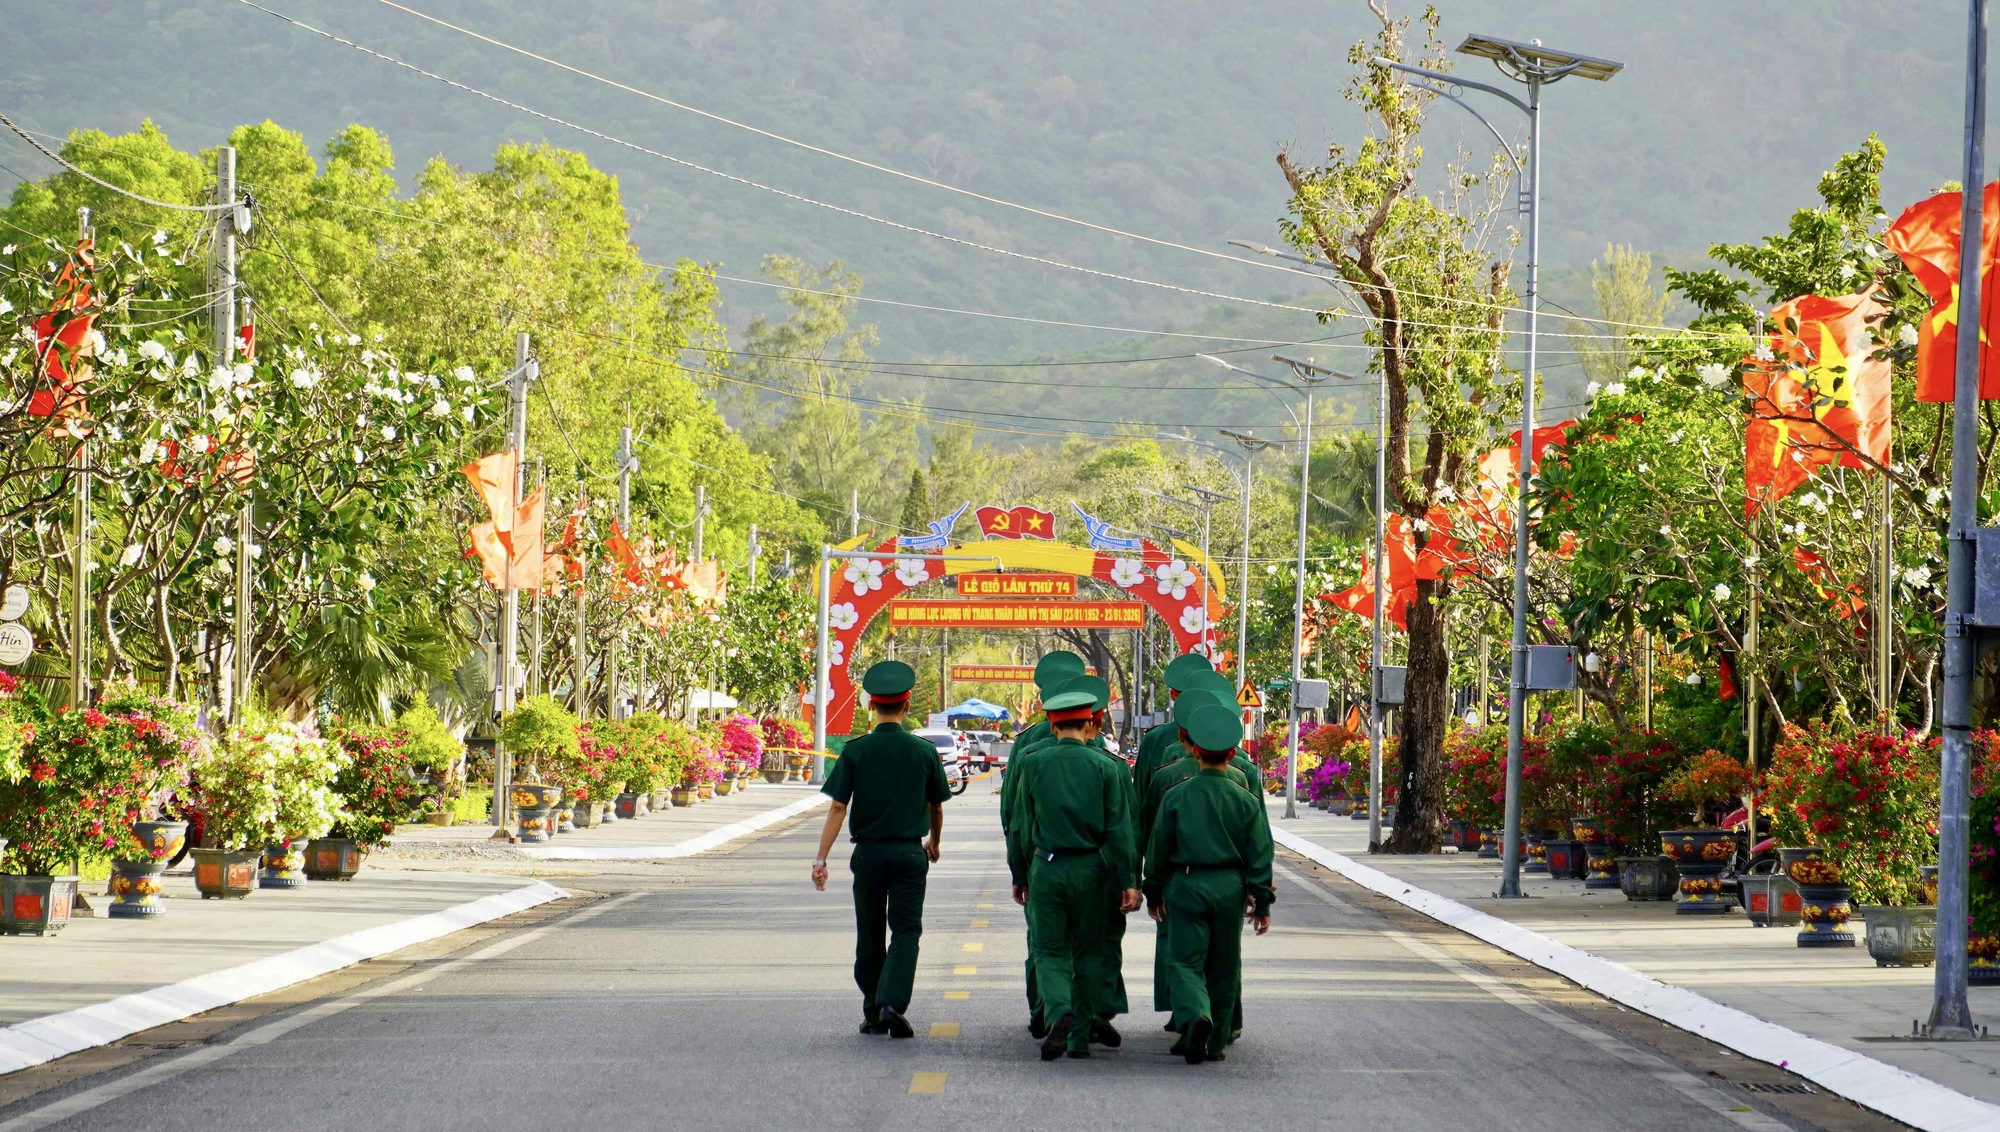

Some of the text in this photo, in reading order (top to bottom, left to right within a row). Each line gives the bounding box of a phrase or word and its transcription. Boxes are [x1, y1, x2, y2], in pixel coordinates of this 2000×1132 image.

[963, 577, 1070, 593] LỄ GIỖ LẦN THỨ 74
[893, 607, 908, 620] ANH
[908, 605, 926, 620] HÙNG
[927, 607, 939, 622] LỰC
[939, 607, 962, 622] LƯỢNG
[972, 607, 994, 621] TRANG
[994, 605, 1014, 621] NHÂN
[1013, 605, 1028, 621] DÂN
[1038, 607, 1050, 623] THỊ
[1049, 605, 1063, 621] SÁU
